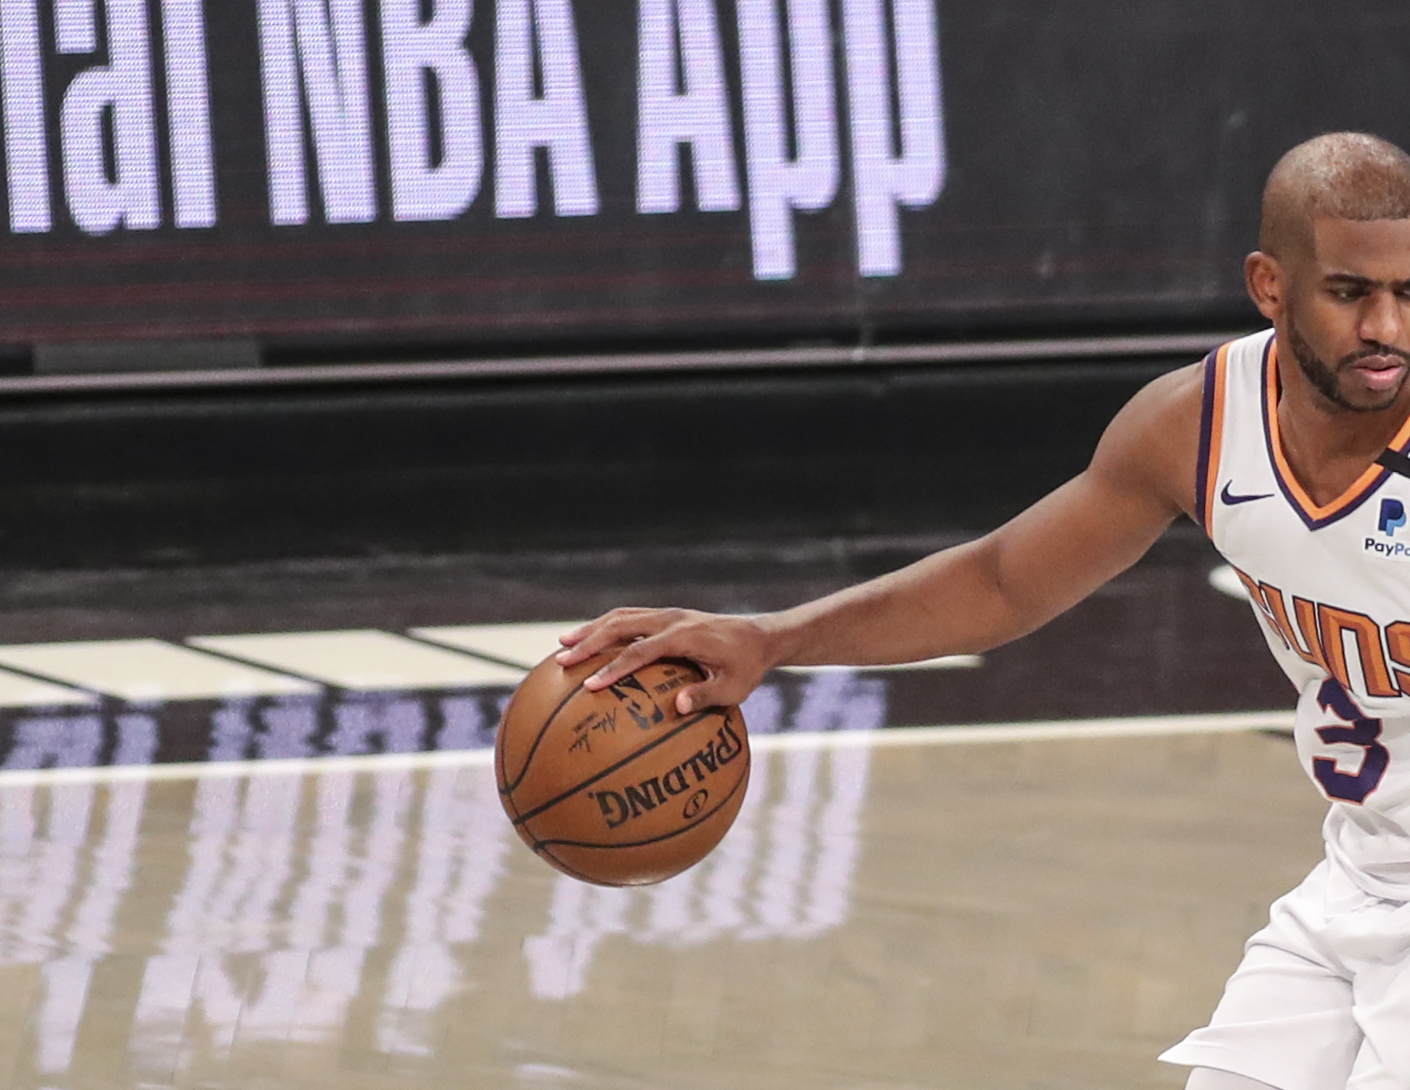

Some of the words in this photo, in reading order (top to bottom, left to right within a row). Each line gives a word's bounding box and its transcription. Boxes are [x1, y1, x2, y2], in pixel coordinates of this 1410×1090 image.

[257, 0, 599, 226] NBA
[635, 0, 947, 280] App
[592, 714, 742, 830] SPALDING
[1312, 678, 1391, 805] 3
